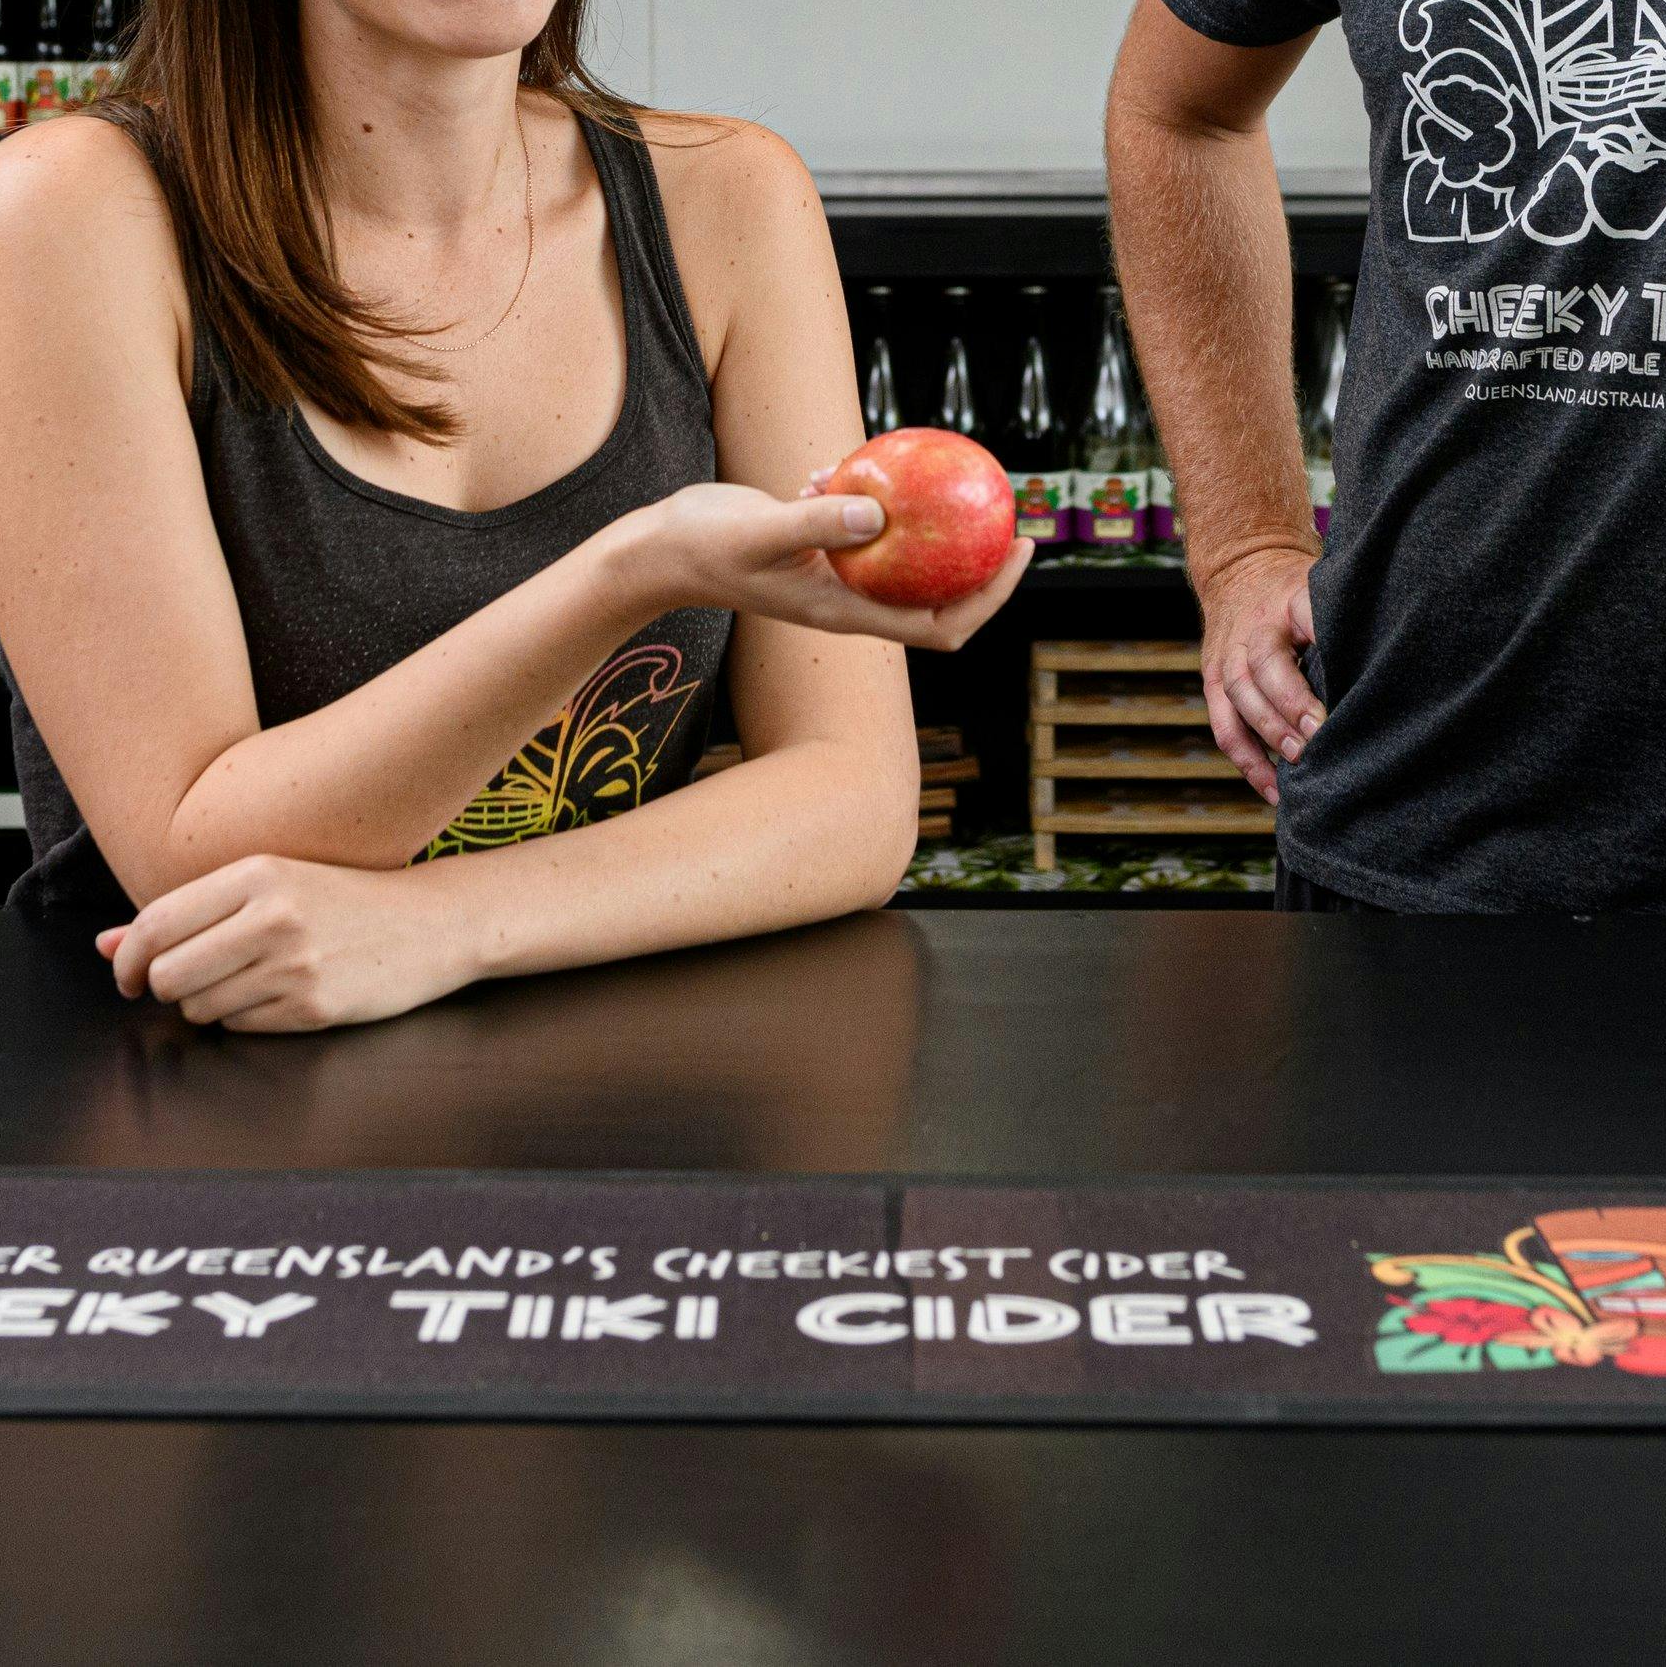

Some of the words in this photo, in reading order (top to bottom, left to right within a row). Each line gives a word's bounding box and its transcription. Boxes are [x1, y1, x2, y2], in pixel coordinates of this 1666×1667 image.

[1425, 283, 1629, 340] CHEEKY
[1588, 351, 1660, 376] APPLE
[1578, 389, 1664, 409] AUSTRALIA
[87, 1242, 618, 1280] QUEENSLAND'S
[653, 1246, 1034, 1280] CHEEKIEST
[1048, 1247, 1245, 1282] CIDER
[388, 1289, 720, 1344] TIKI
[795, 1292, 1319, 1347] CIDER
